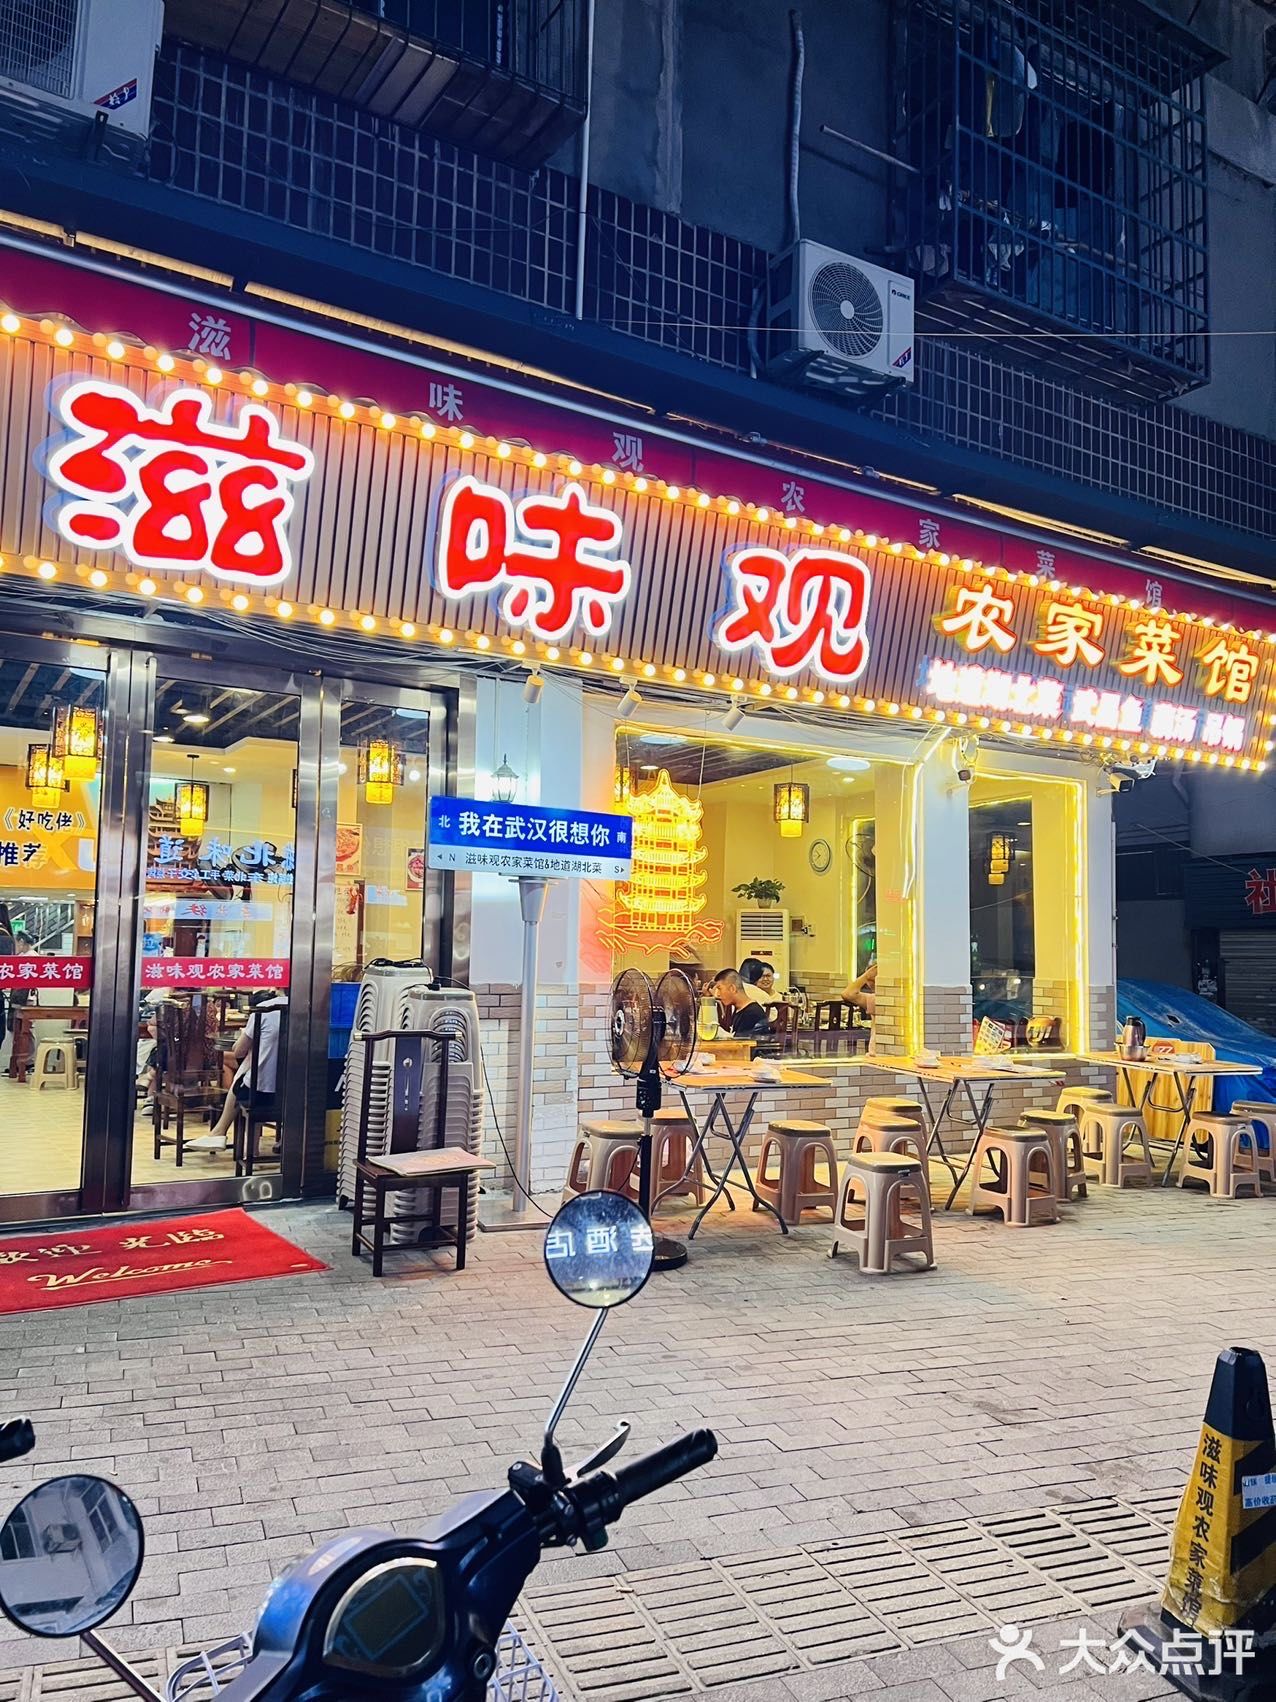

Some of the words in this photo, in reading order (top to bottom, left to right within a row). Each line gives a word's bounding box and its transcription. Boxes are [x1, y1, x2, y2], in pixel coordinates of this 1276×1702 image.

[49, 380, 872, 683] 滋味观
[940, 583, 1259, 704] 农家菜馆
[4, 807, 86, 832] 《好吃佬》
[438, 814, 450, 828] 北
[458, 811, 610, 847] 我在武汉很想你
[616, 831, 626, 843] 南
[448, 853, 456, 862] N
[465, 852, 602, 874] 滋味观农家菜馆&地道湖北菜
[614, 864, 620, 874] S
[0, 962, 84, 980] 农家菜馆
[145, 963, 284, 980] 滋味观农家菜馆
[27, 1260, 232, 1291] Welcome
[1181, 1433, 1222, 1628] 滋味观农家菜馆
